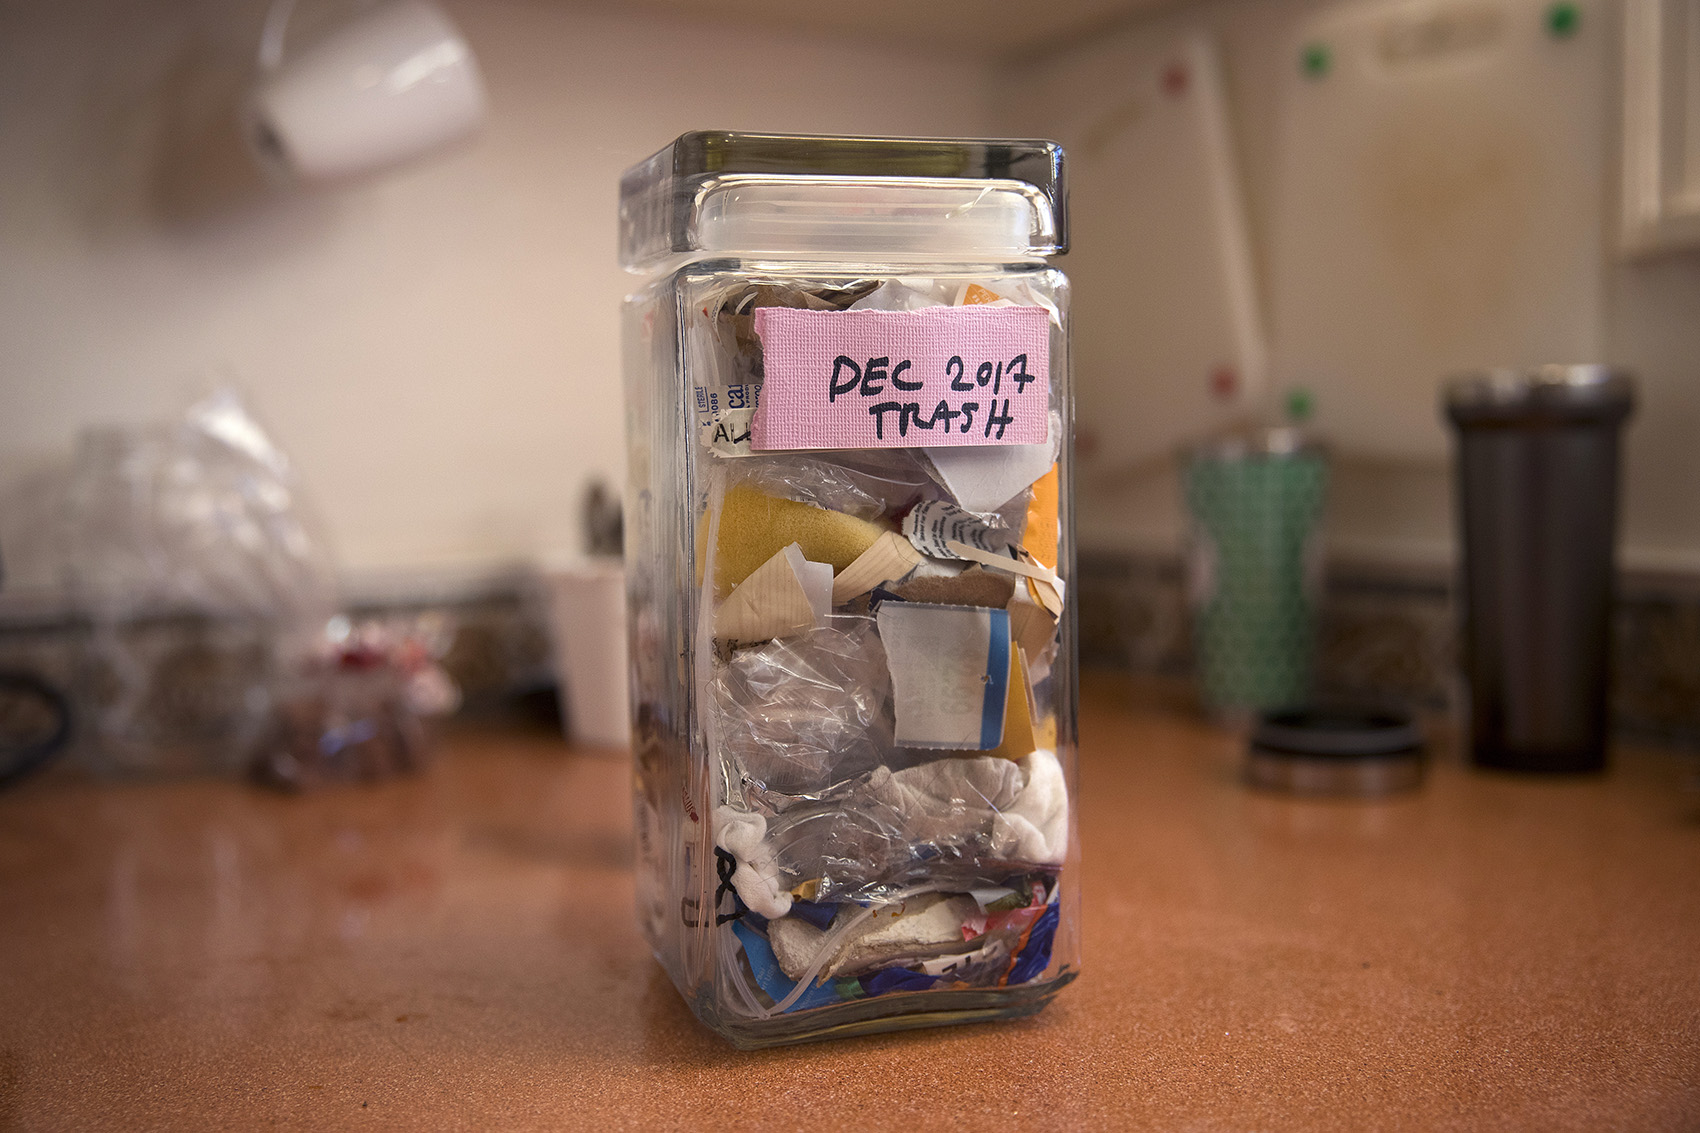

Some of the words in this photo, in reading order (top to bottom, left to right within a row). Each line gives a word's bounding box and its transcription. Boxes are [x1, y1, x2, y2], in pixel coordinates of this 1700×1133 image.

[695, 386, 706, 408] STERILE
[829, 355, 924, 404] DEC
[945, 353, 1036, 396] 2017
[868, 399, 1014, 441] TRASH
